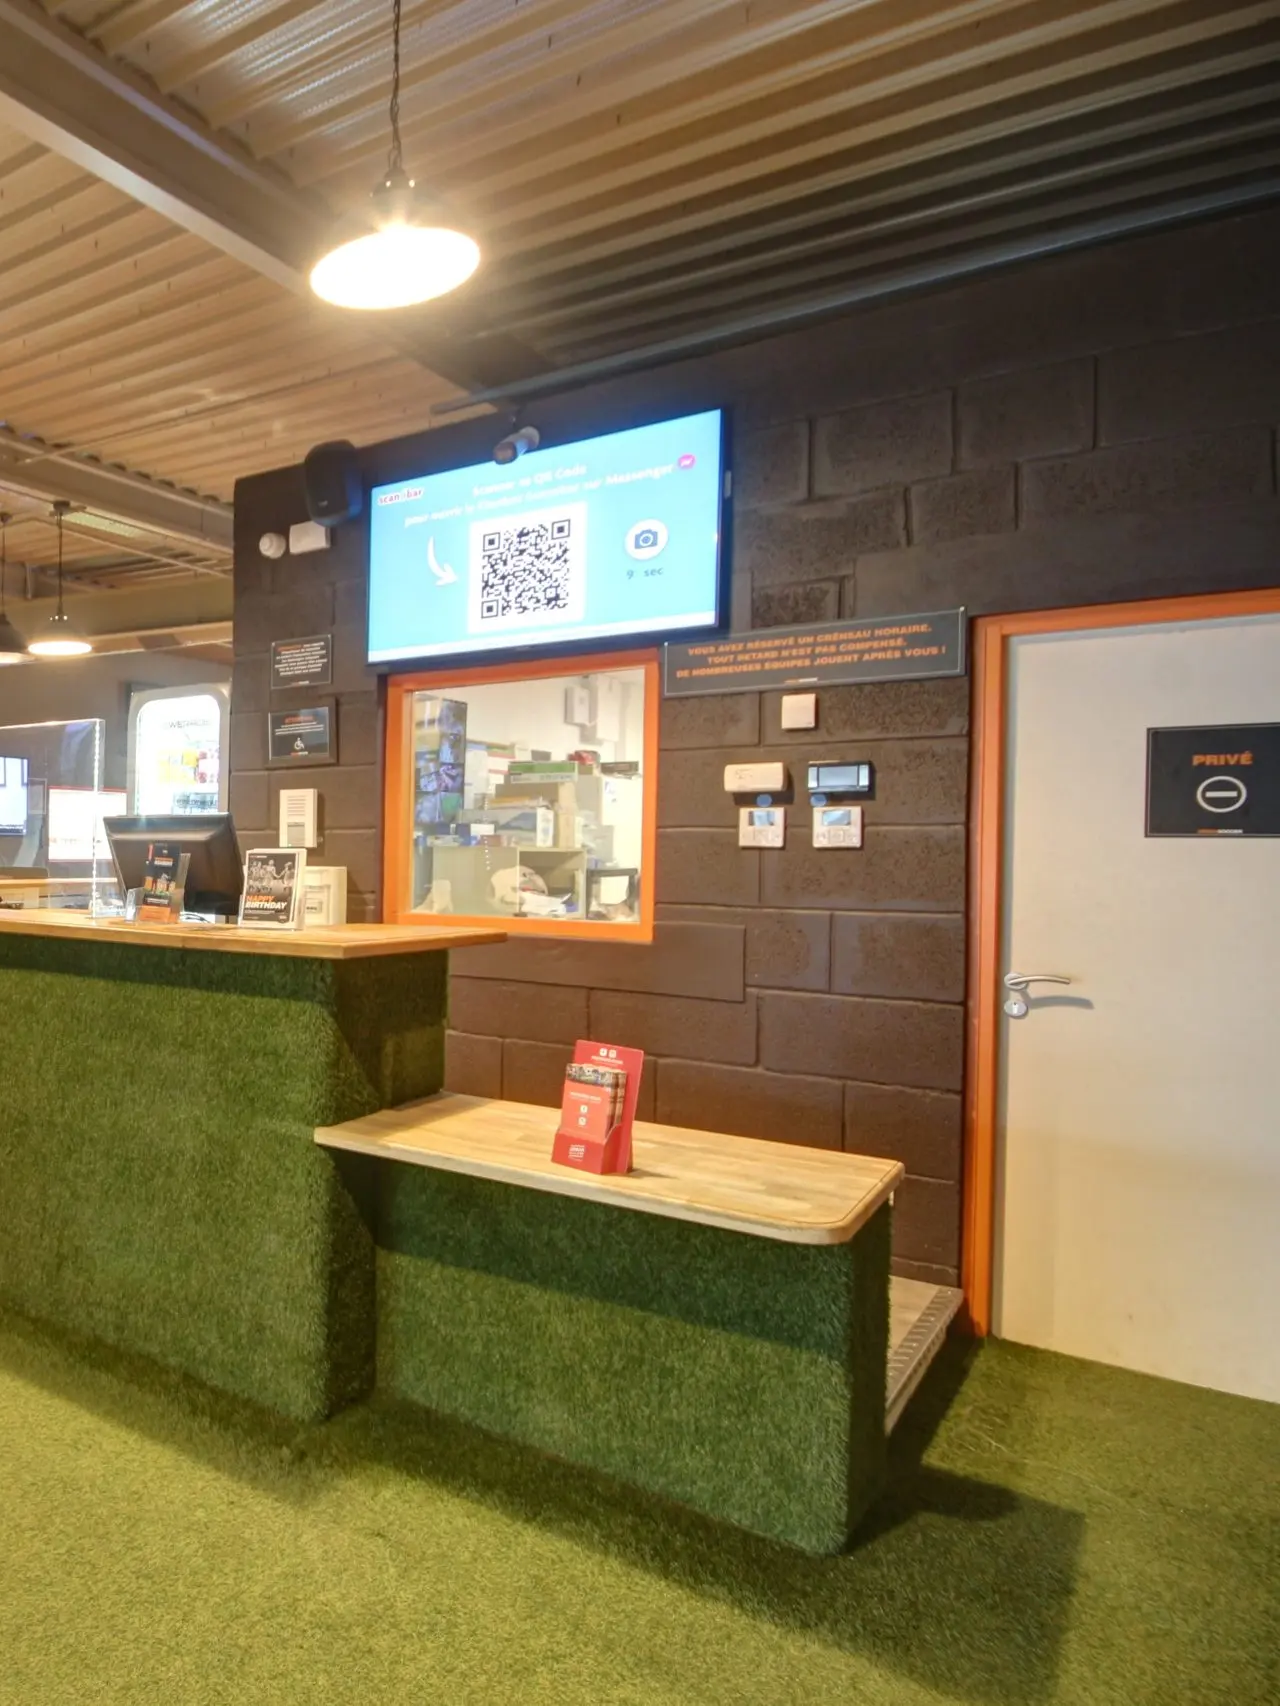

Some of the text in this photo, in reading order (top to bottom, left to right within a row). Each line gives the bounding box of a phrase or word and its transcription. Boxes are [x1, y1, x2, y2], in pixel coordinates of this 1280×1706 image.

[606, 464, 674, 486] Messenger
[644, 567, 663, 577] sec
[688, 624, 932, 656] VOUS AVEZ RÉSERVÉ UN CRÉNEAU HORAIRE.
[676, 668, 690, 679] DE
[692, 663, 761, 677] NOMBREUSES
[764, 657, 811, 672] ÉQUIPES
[814, 653, 858, 667] JOUENT
[862, 648, 901, 662] APRÈS
[904, 646, 937, 658] VOUS
[707, 638, 907, 665] TOUT RETARD N'EST PAS COMPENSÉ.
[1192, 750, 1254, 766] PRIVÉ
[245, 901, 288, 911] BIRTHDAY
